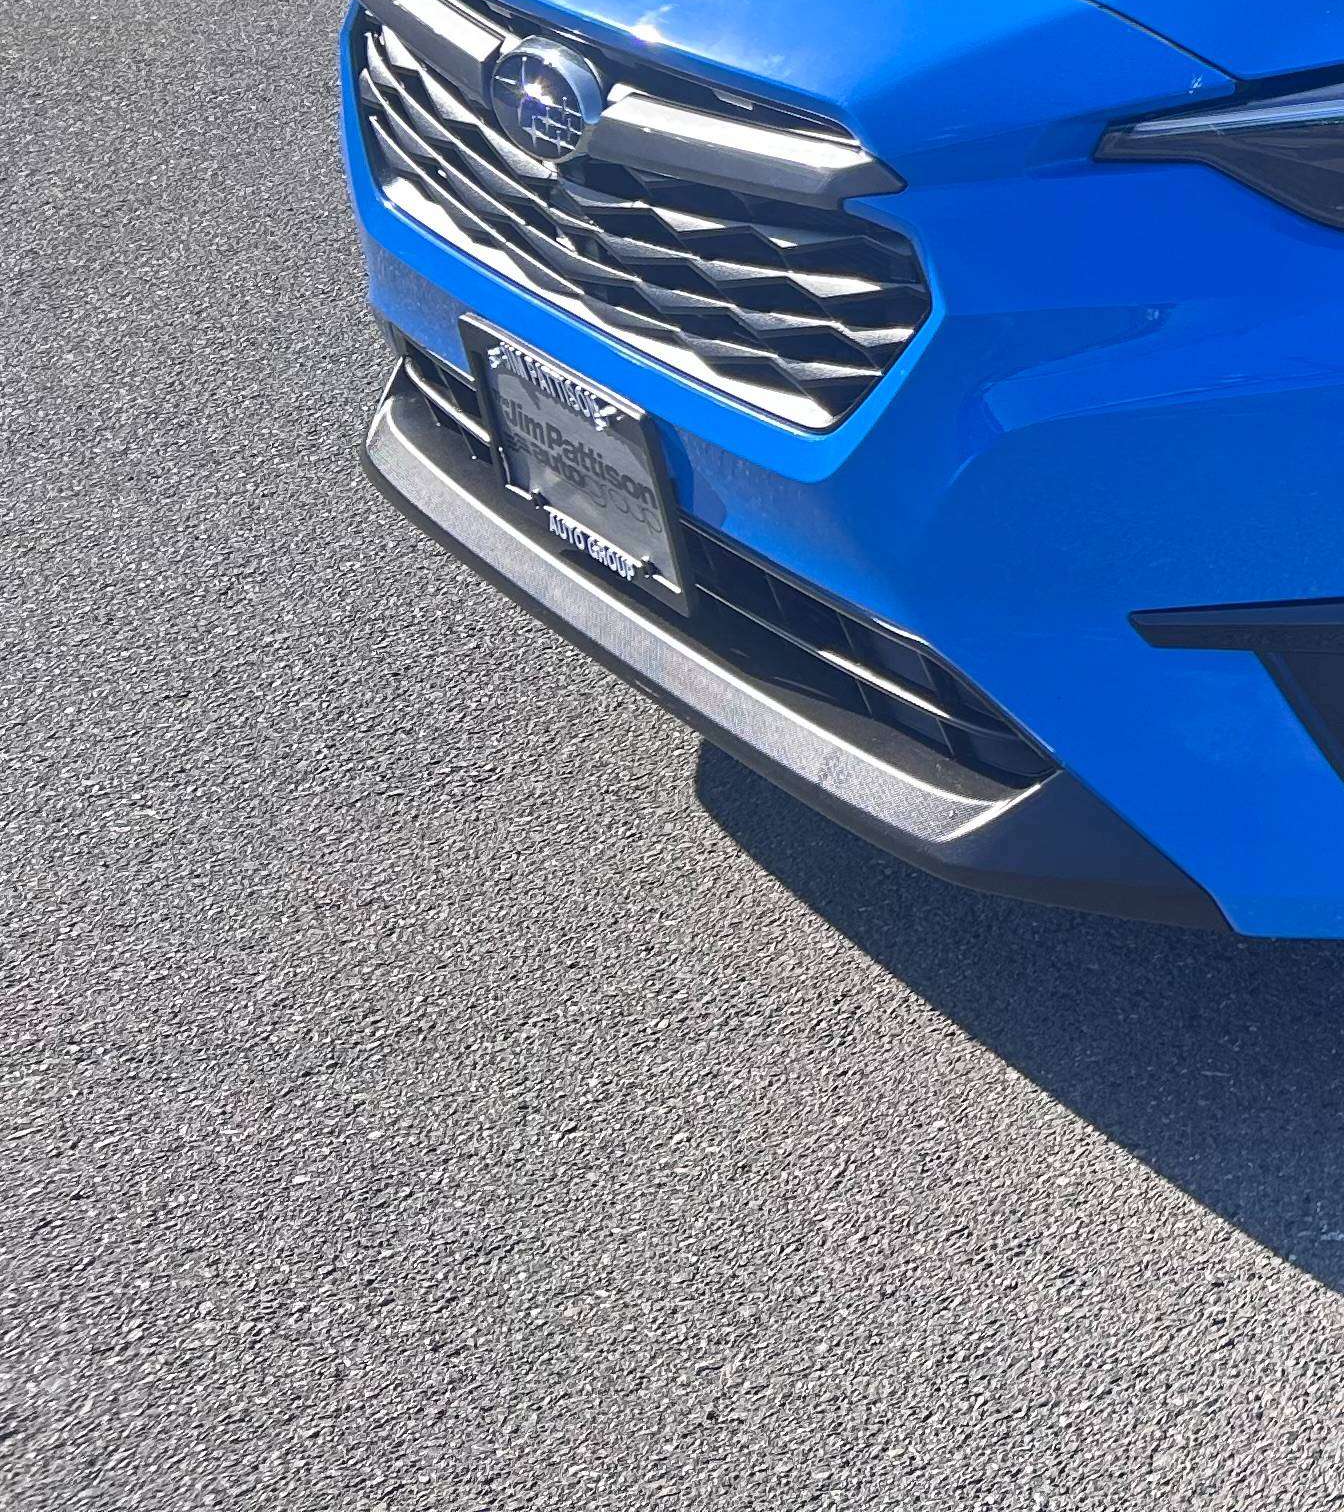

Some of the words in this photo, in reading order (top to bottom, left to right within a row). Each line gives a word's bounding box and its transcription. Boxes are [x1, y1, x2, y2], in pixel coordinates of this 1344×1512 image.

[546, 422, 659, 511] Pattison
[550, 513, 586, 551] AUTO
[587, 536, 635, 582] GROUP
